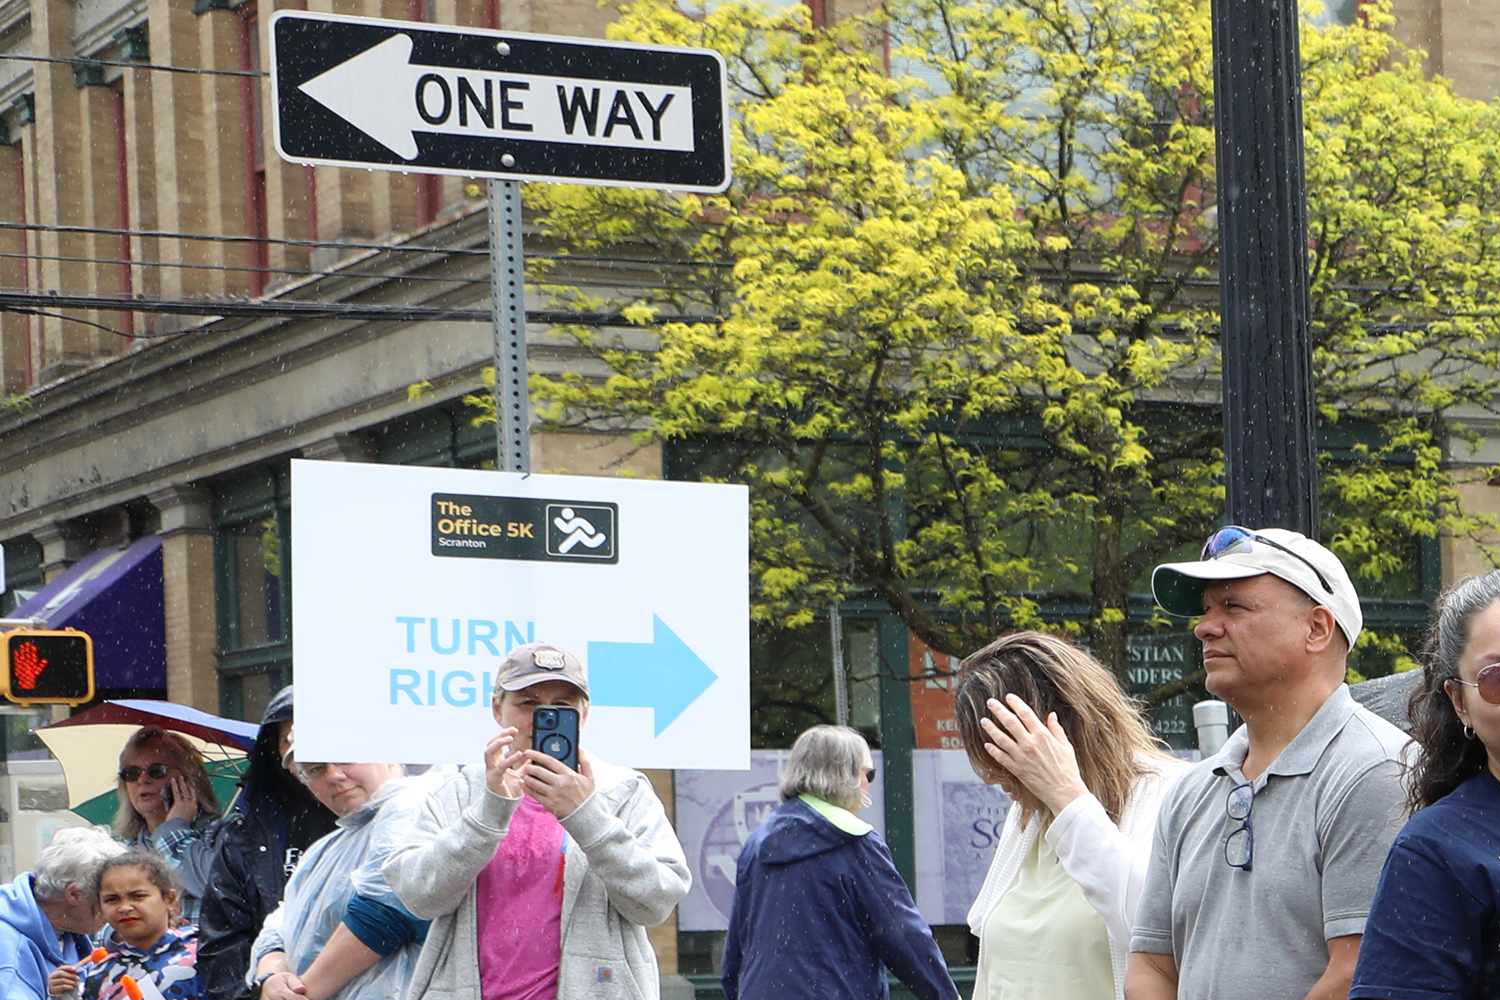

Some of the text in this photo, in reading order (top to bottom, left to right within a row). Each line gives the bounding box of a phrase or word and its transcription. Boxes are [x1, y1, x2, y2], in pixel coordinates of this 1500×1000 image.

[415, 72, 676, 143] ONE WAY
[437, 500, 472, 518] The
[437, 518, 535, 540] Office 5K
[437, 536, 487, 550] Scranton
[395, 616, 535, 657] TURN
[390, 668, 495, 708] RIGH
